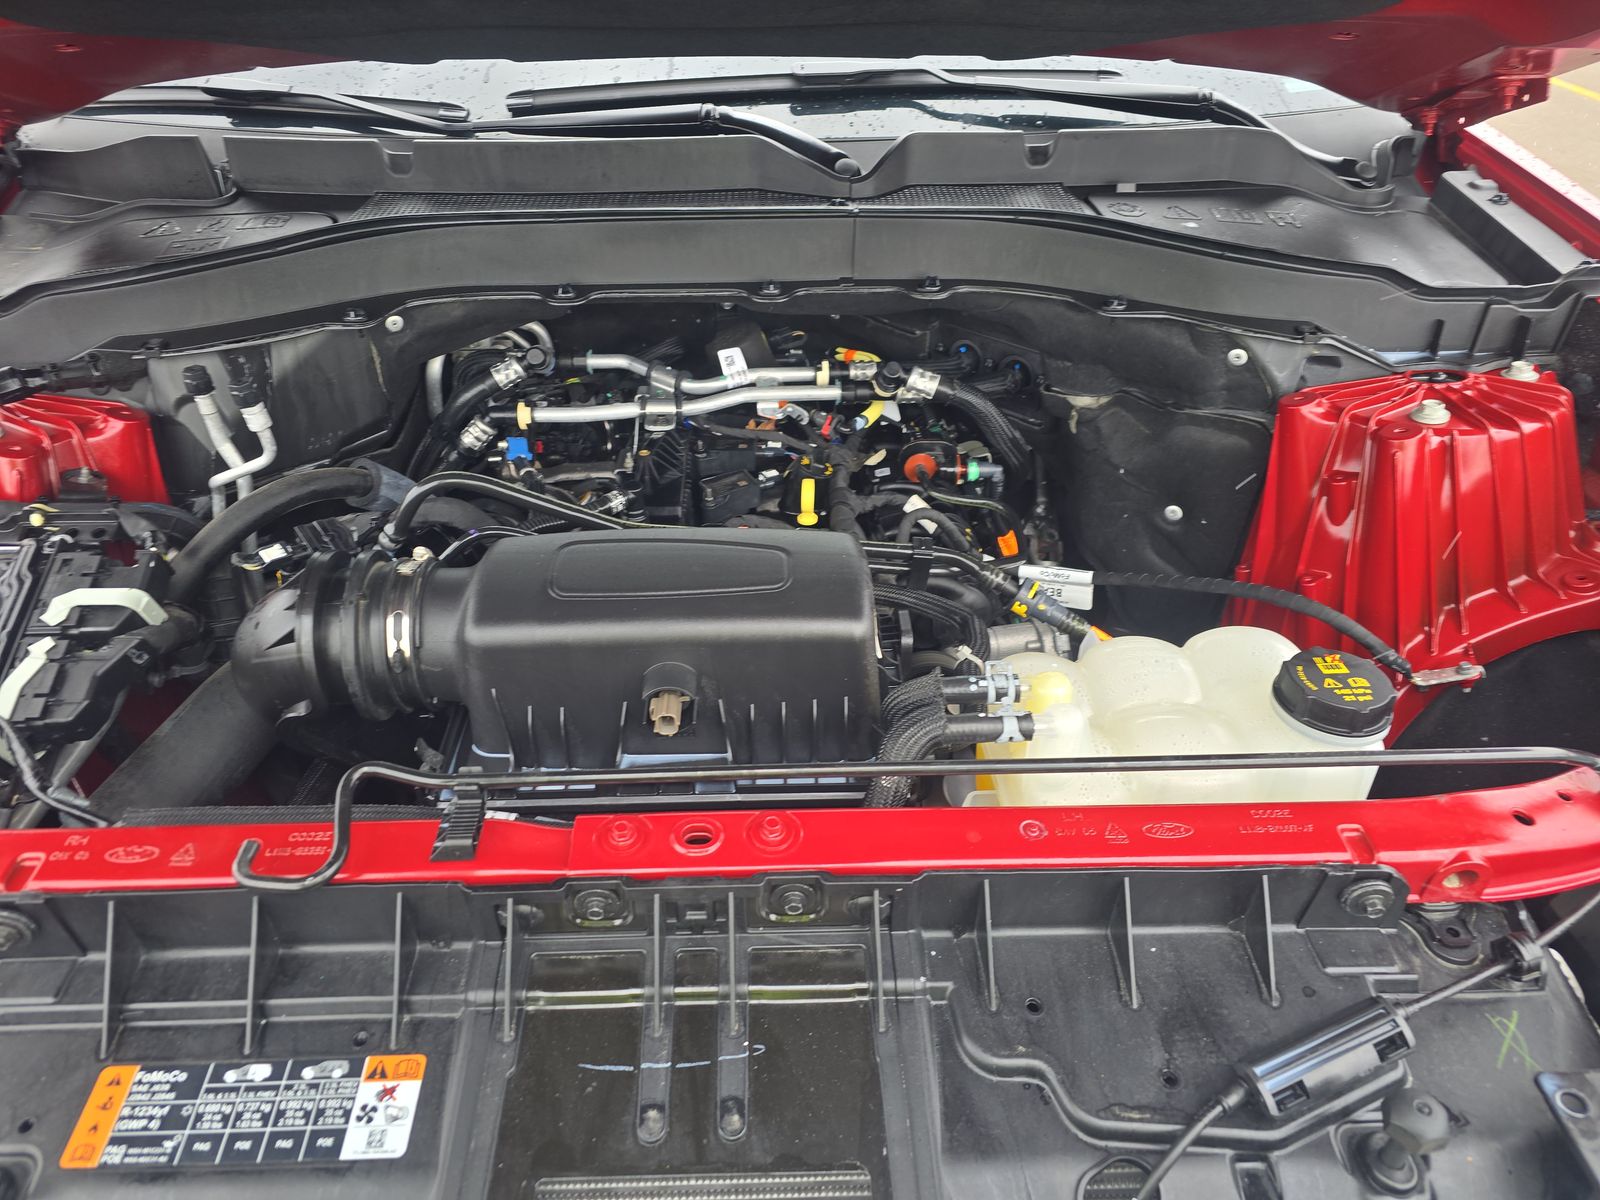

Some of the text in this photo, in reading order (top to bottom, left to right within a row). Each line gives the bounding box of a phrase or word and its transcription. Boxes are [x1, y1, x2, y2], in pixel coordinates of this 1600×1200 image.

[134, 1070, 188, 1083] FoMoCo
[120, 1105, 171, 1118] R-1234yf
[114, 1119, 161, 1131] (GWP 4)
[192, 1141, 212, 1152] PAG
[234, 1140, 253, 1150] POE
[275, 1138, 294, 1149] PAG
[316, 1137, 335, 1147] POE
[104, 1144, 128, 1154] PAG
[100, 1154, 125, 1164] POE
